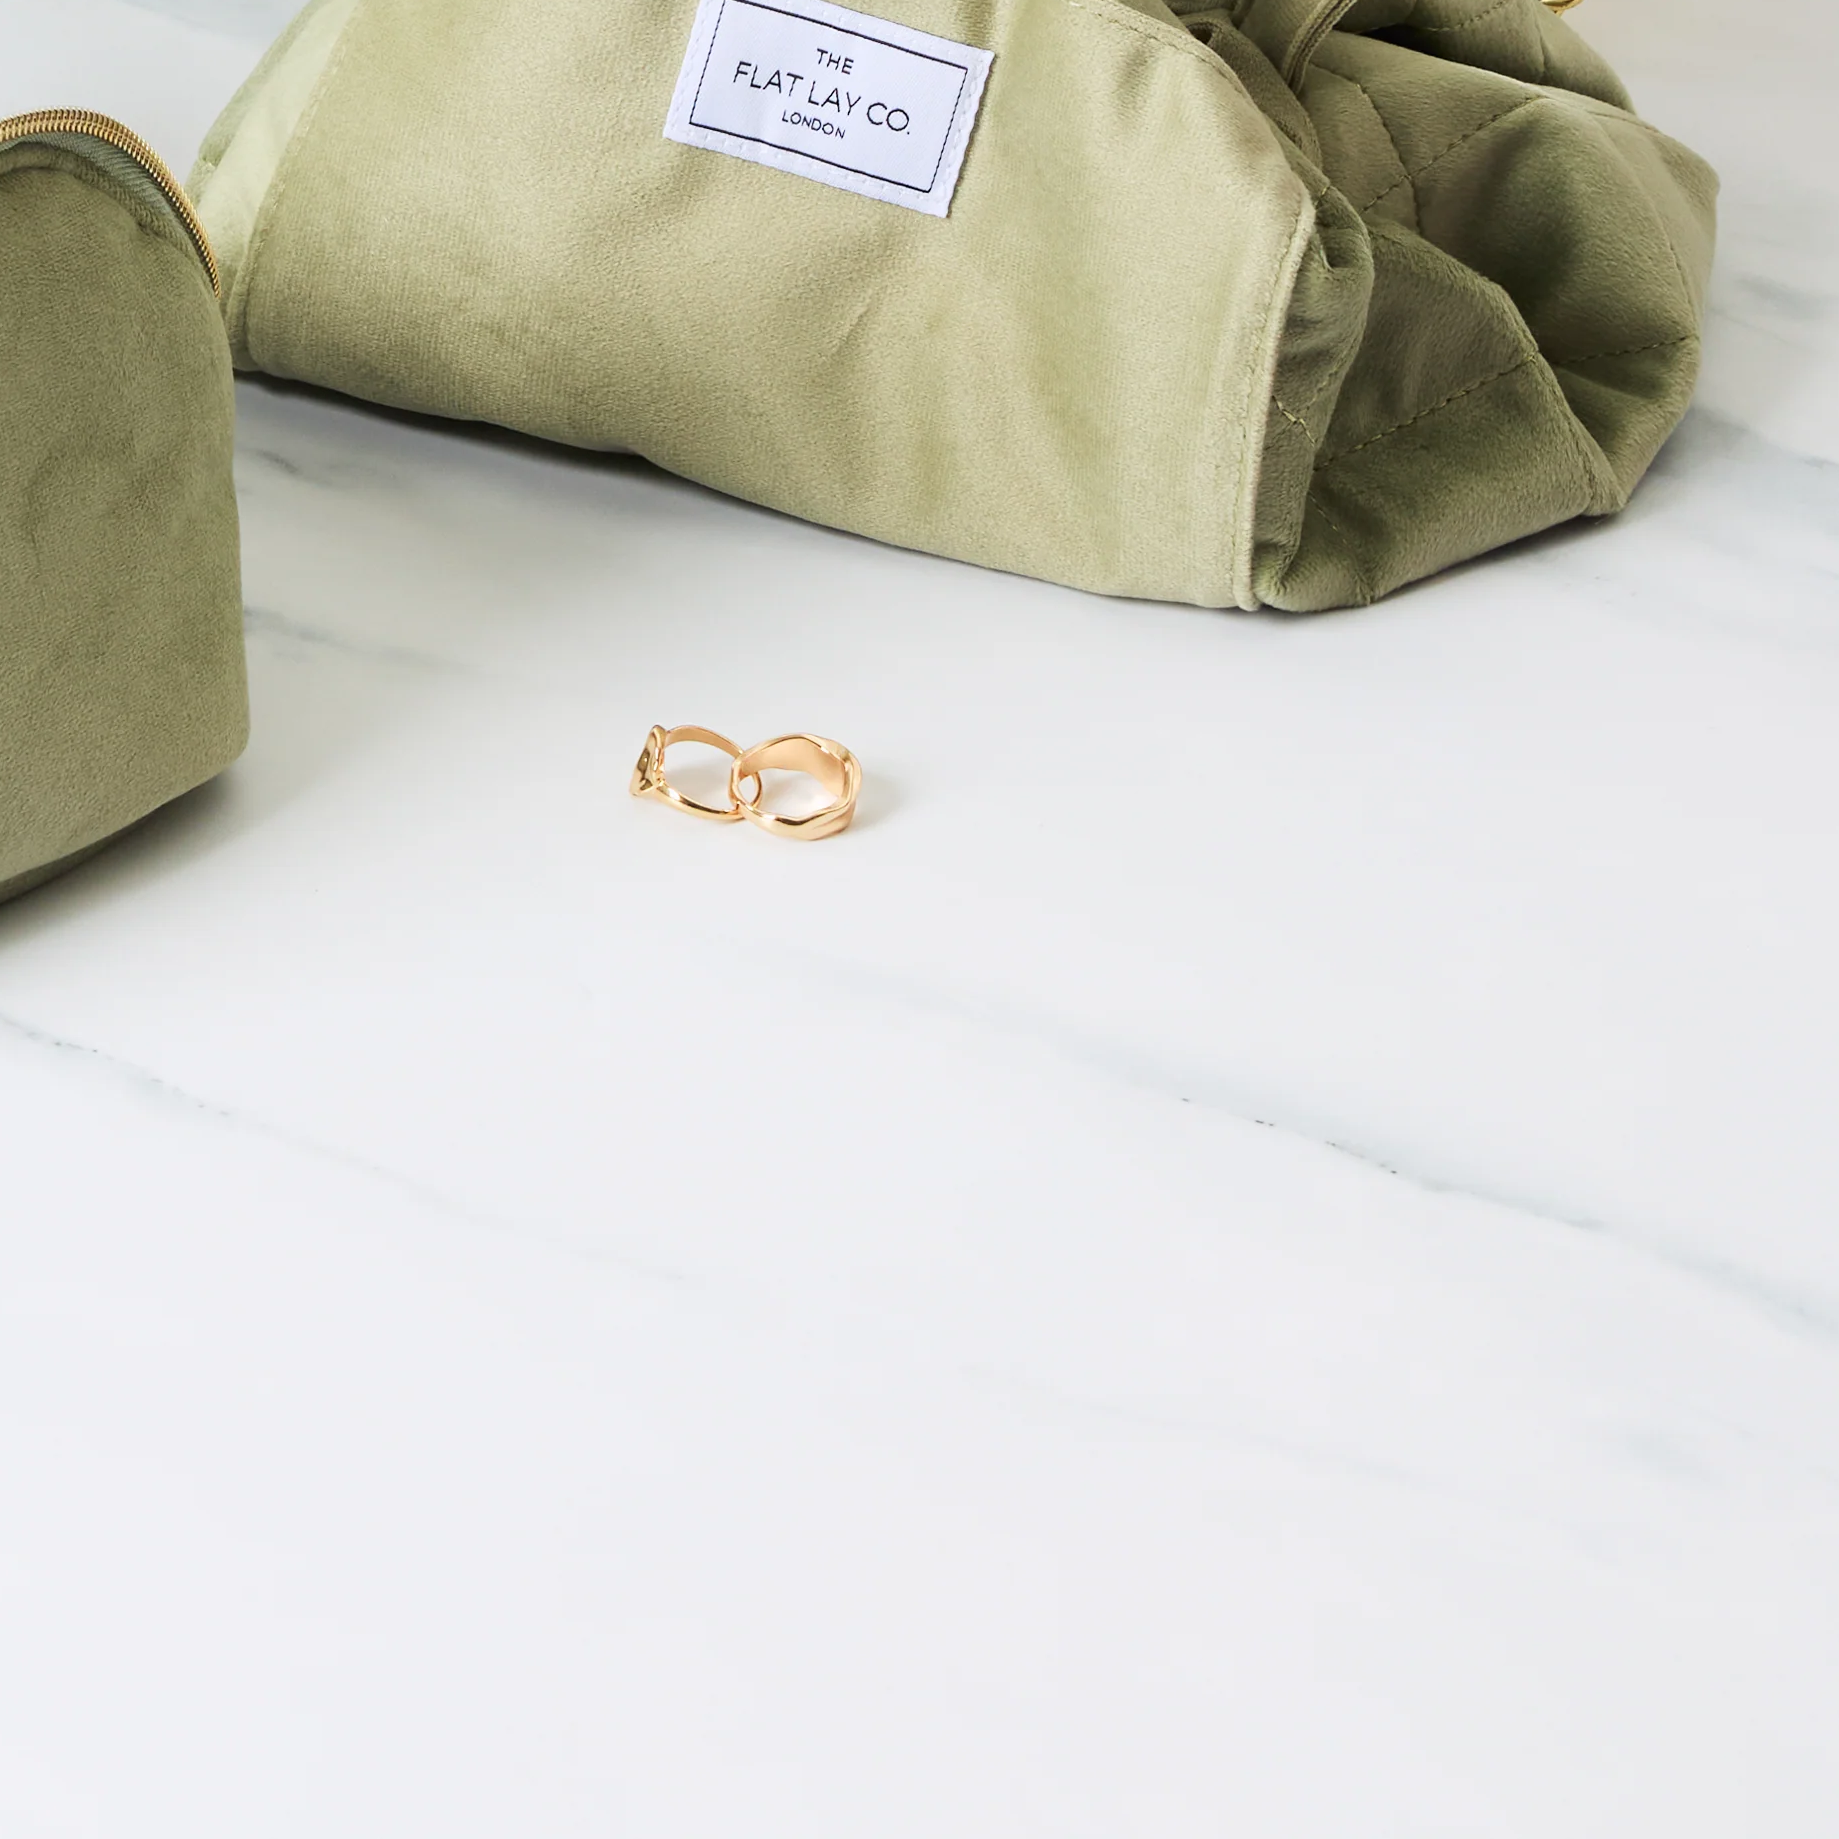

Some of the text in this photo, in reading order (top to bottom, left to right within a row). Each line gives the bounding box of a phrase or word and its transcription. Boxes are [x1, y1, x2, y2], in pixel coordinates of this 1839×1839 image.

[816, 47, 855, 75] THE
[732, 60, 911, 135] FLAT LAY CO.
[781, 109, 847, 139] LONDON
